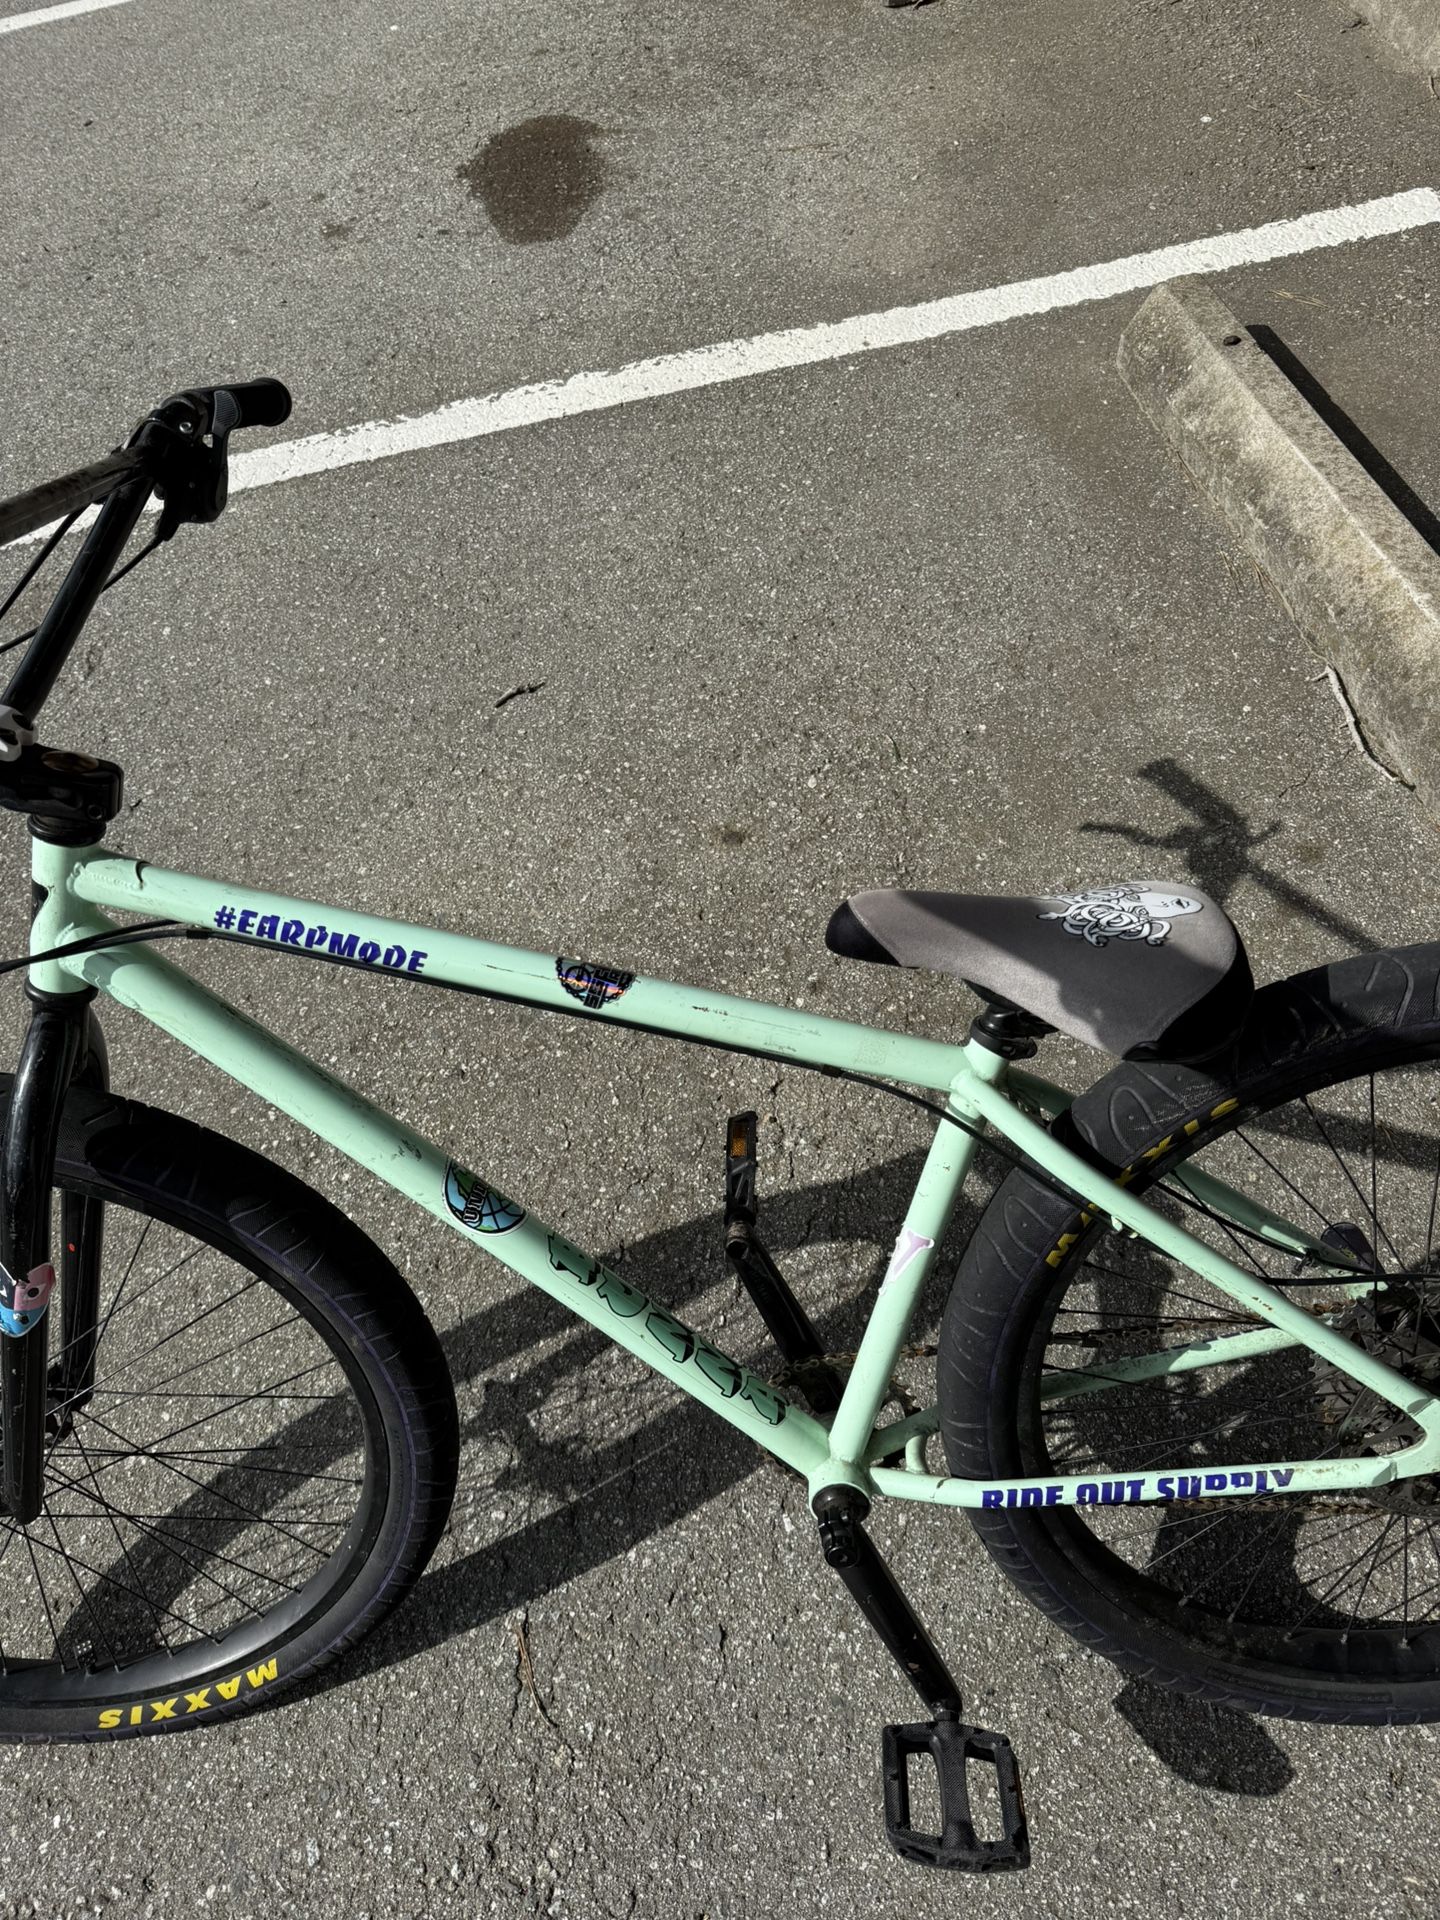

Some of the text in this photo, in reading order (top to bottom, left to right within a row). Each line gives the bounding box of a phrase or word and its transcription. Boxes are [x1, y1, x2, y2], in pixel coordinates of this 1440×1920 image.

[213, 904, 429, 974] #EARPMODE
[981, 1467, 1296, 1510] RIDE OUT SUPPLY
[97, 1657, 279, 1730] MAXXIS
